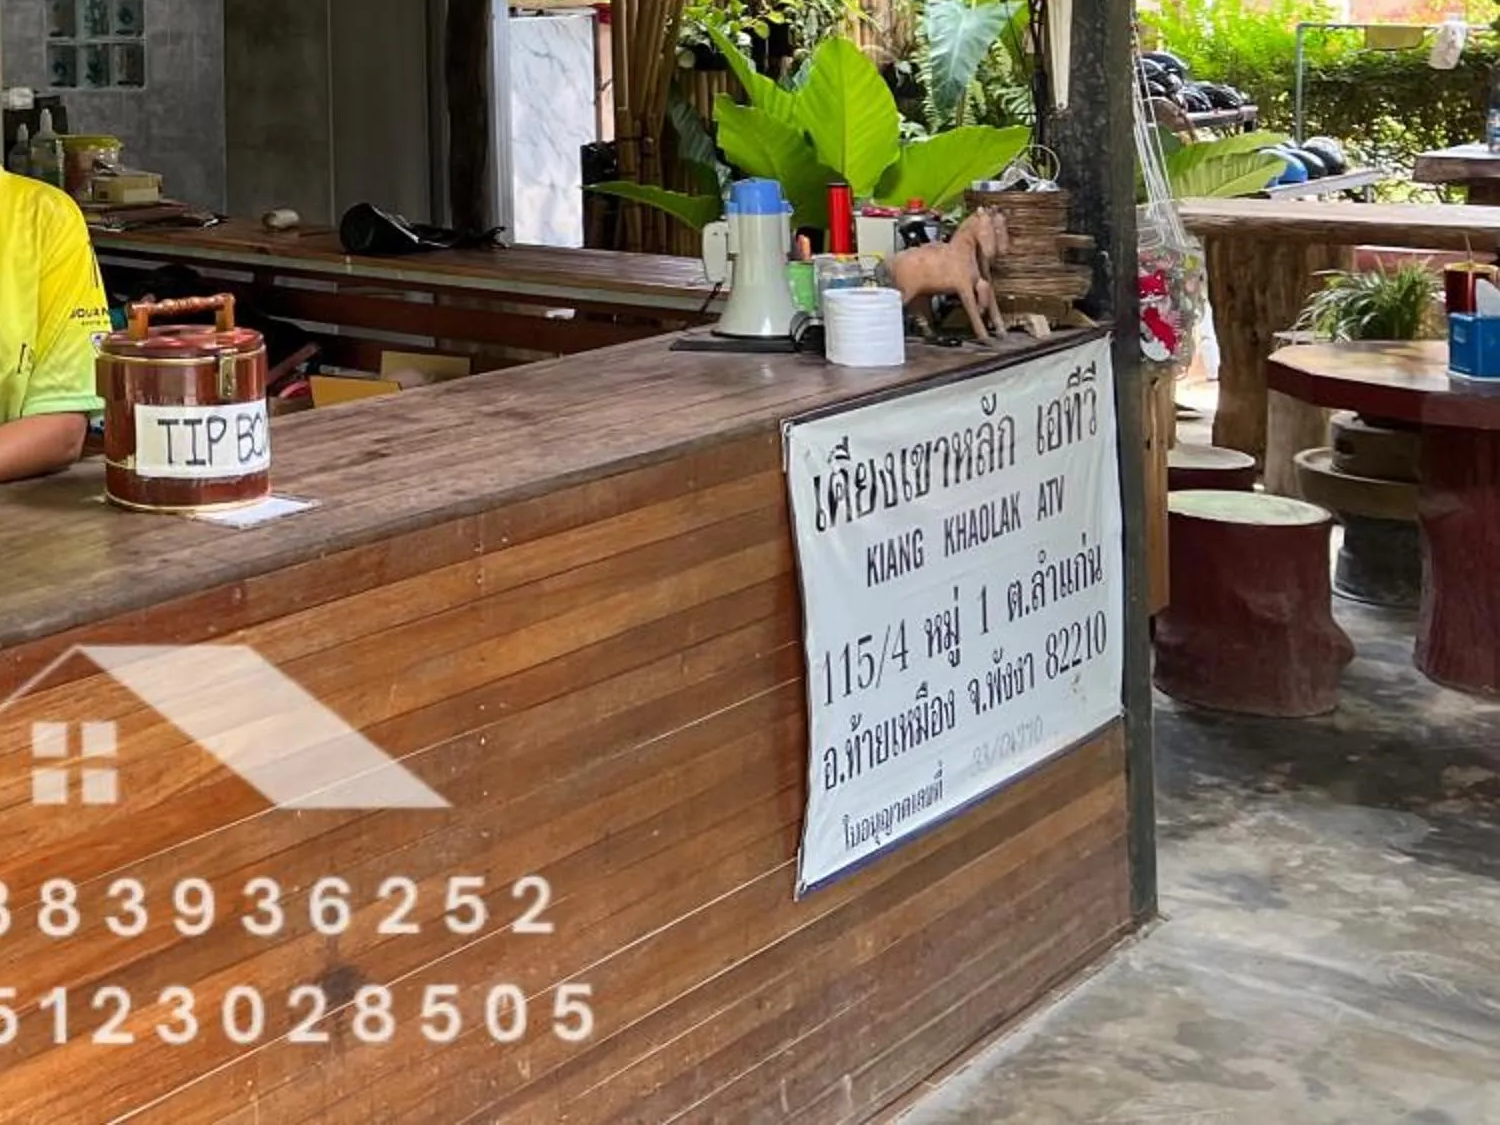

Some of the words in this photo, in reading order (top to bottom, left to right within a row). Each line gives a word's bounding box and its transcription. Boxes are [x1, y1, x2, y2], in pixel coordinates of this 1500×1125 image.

[157, 415, 227, 467] TIP
[813, 393, 1016, 533] เคียงเขาหลัก
[1037, 361, 1098, 455] เอทีวี
[867, 528, 924, 588] KIANG
[944, 491, 1021, 558] KHAOLAK
[1037, 474, 1065, 522] ATV
[823, 618, 909, 707] 115/4
[924, 586, 961, 668] หมู่
[979, 585, 989, 636] 1
[1007, 532, 1104, 623] ต.ลำแก่น
[823, 681, 956, 792] อ.ท้ายเหมือง
[1045, 609, 1108, 680] 82210
